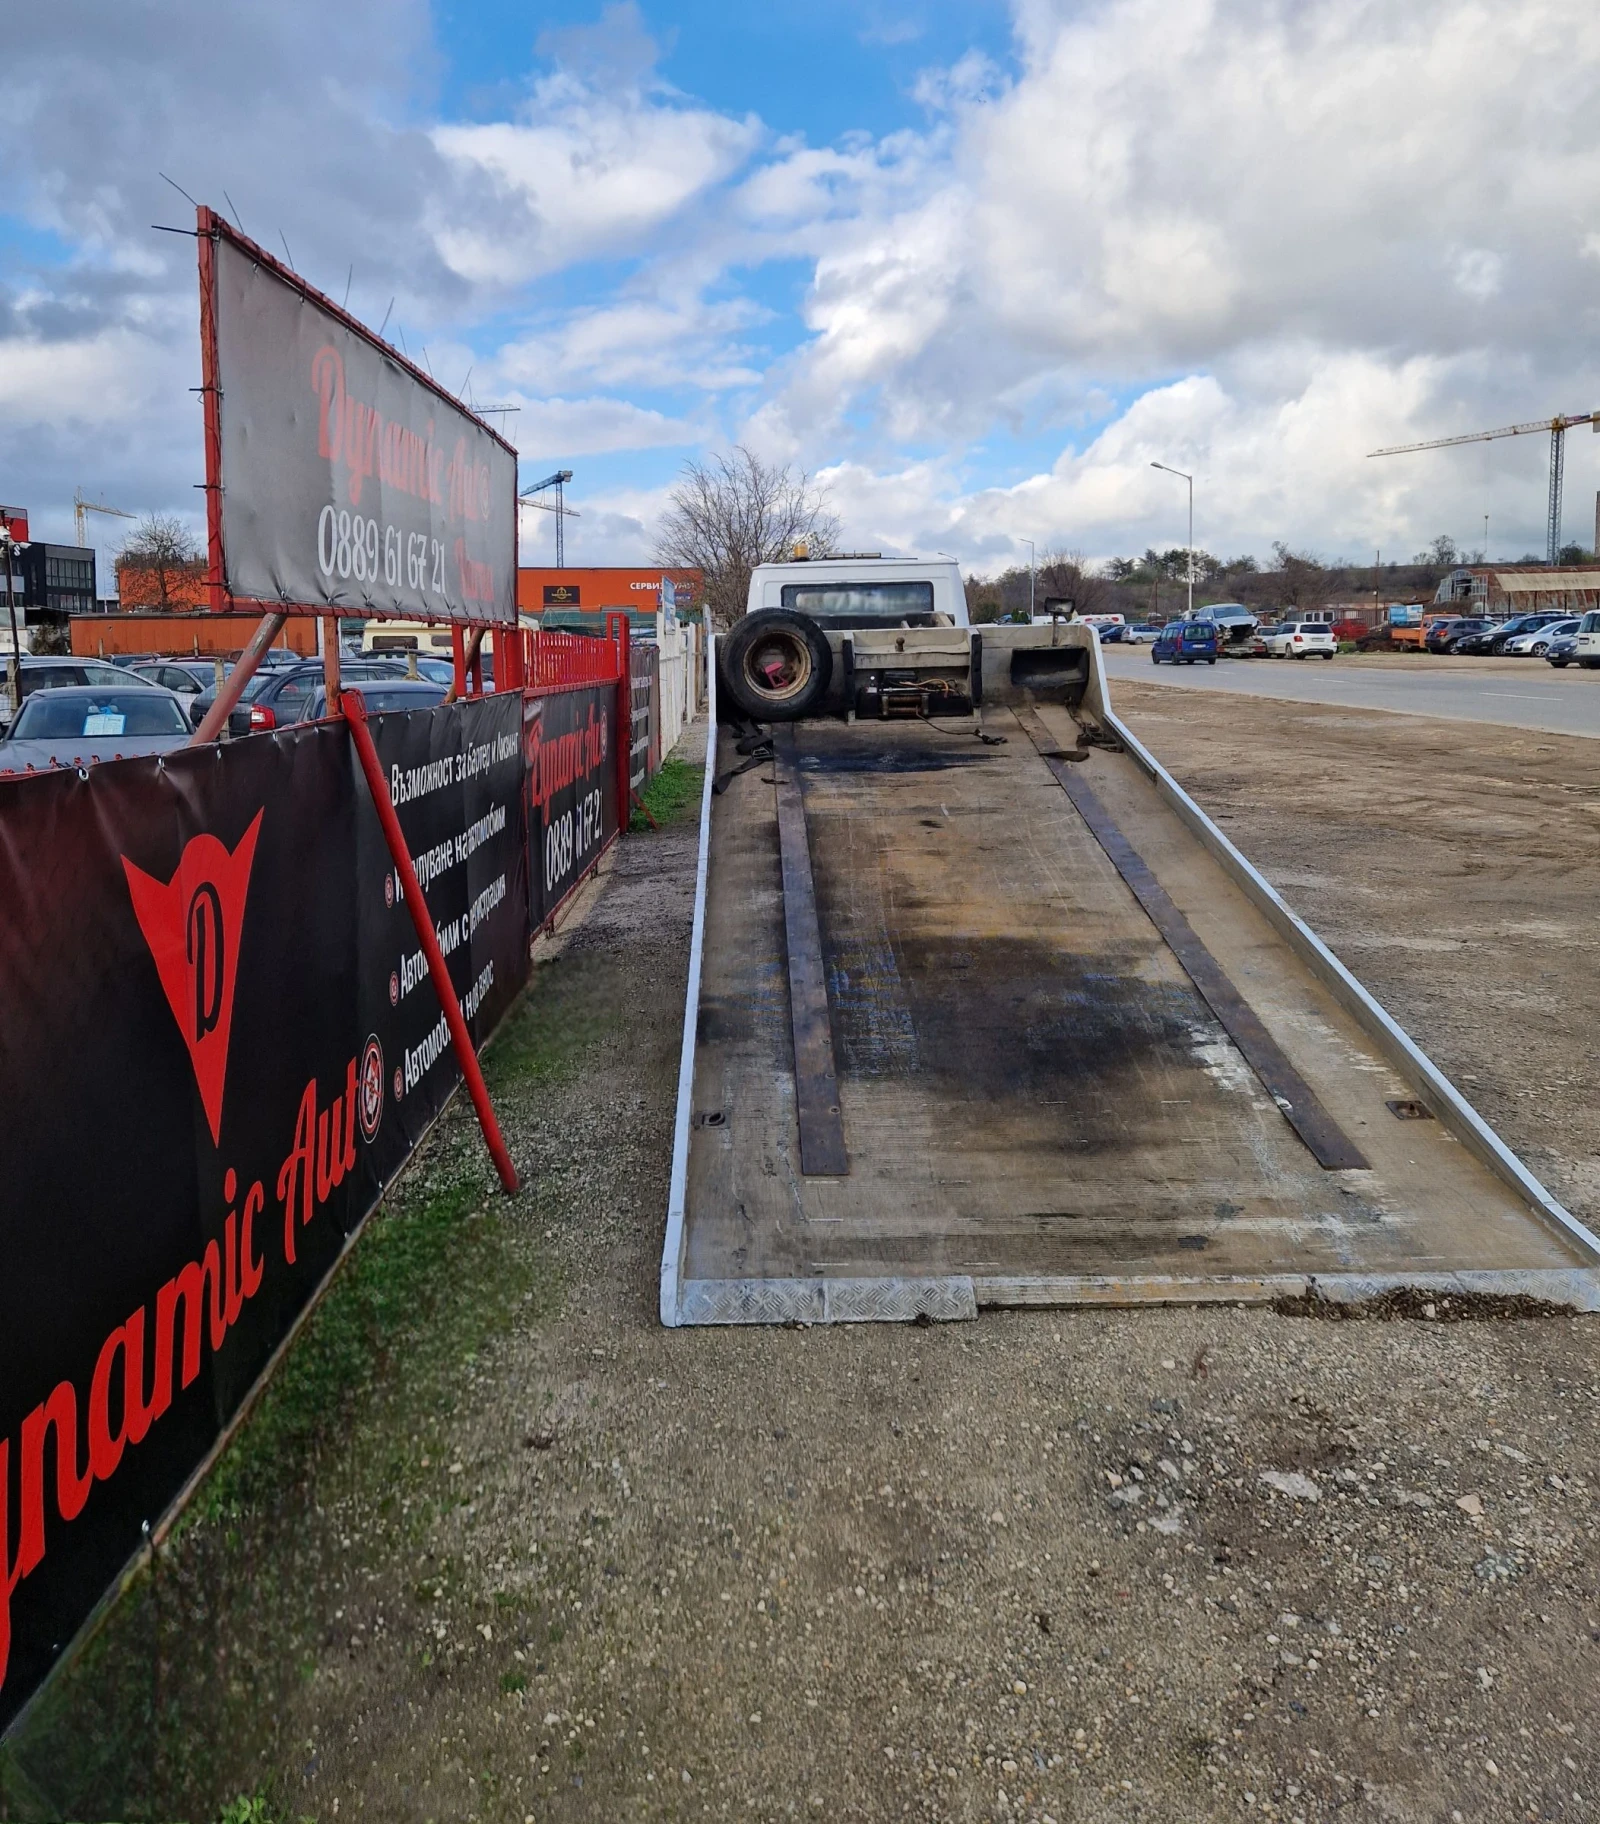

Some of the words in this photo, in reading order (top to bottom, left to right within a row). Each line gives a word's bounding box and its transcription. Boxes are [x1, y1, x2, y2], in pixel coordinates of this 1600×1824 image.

[311, 344, 444, 507] Dynamic
[317, 504, 380, 583] 0889
[384, 524, 403, 588] 61
[407, 530, 428, 591] 67
[431, 537, 446, 595] 21
[391, 756, 454, 807] Възможност
[455, 753, 467, 782] за
[467, 741, 491, 781] бартер
[393, 838, 454, 902] Иупуване
[454, 832, 468, 864] на
[545, 809, 573, 892] 0889
[583, 792, 594, 851] 67
[400, 920, 461, 1000] Автобили
[404, 999, 464, 1095] Автомоби
